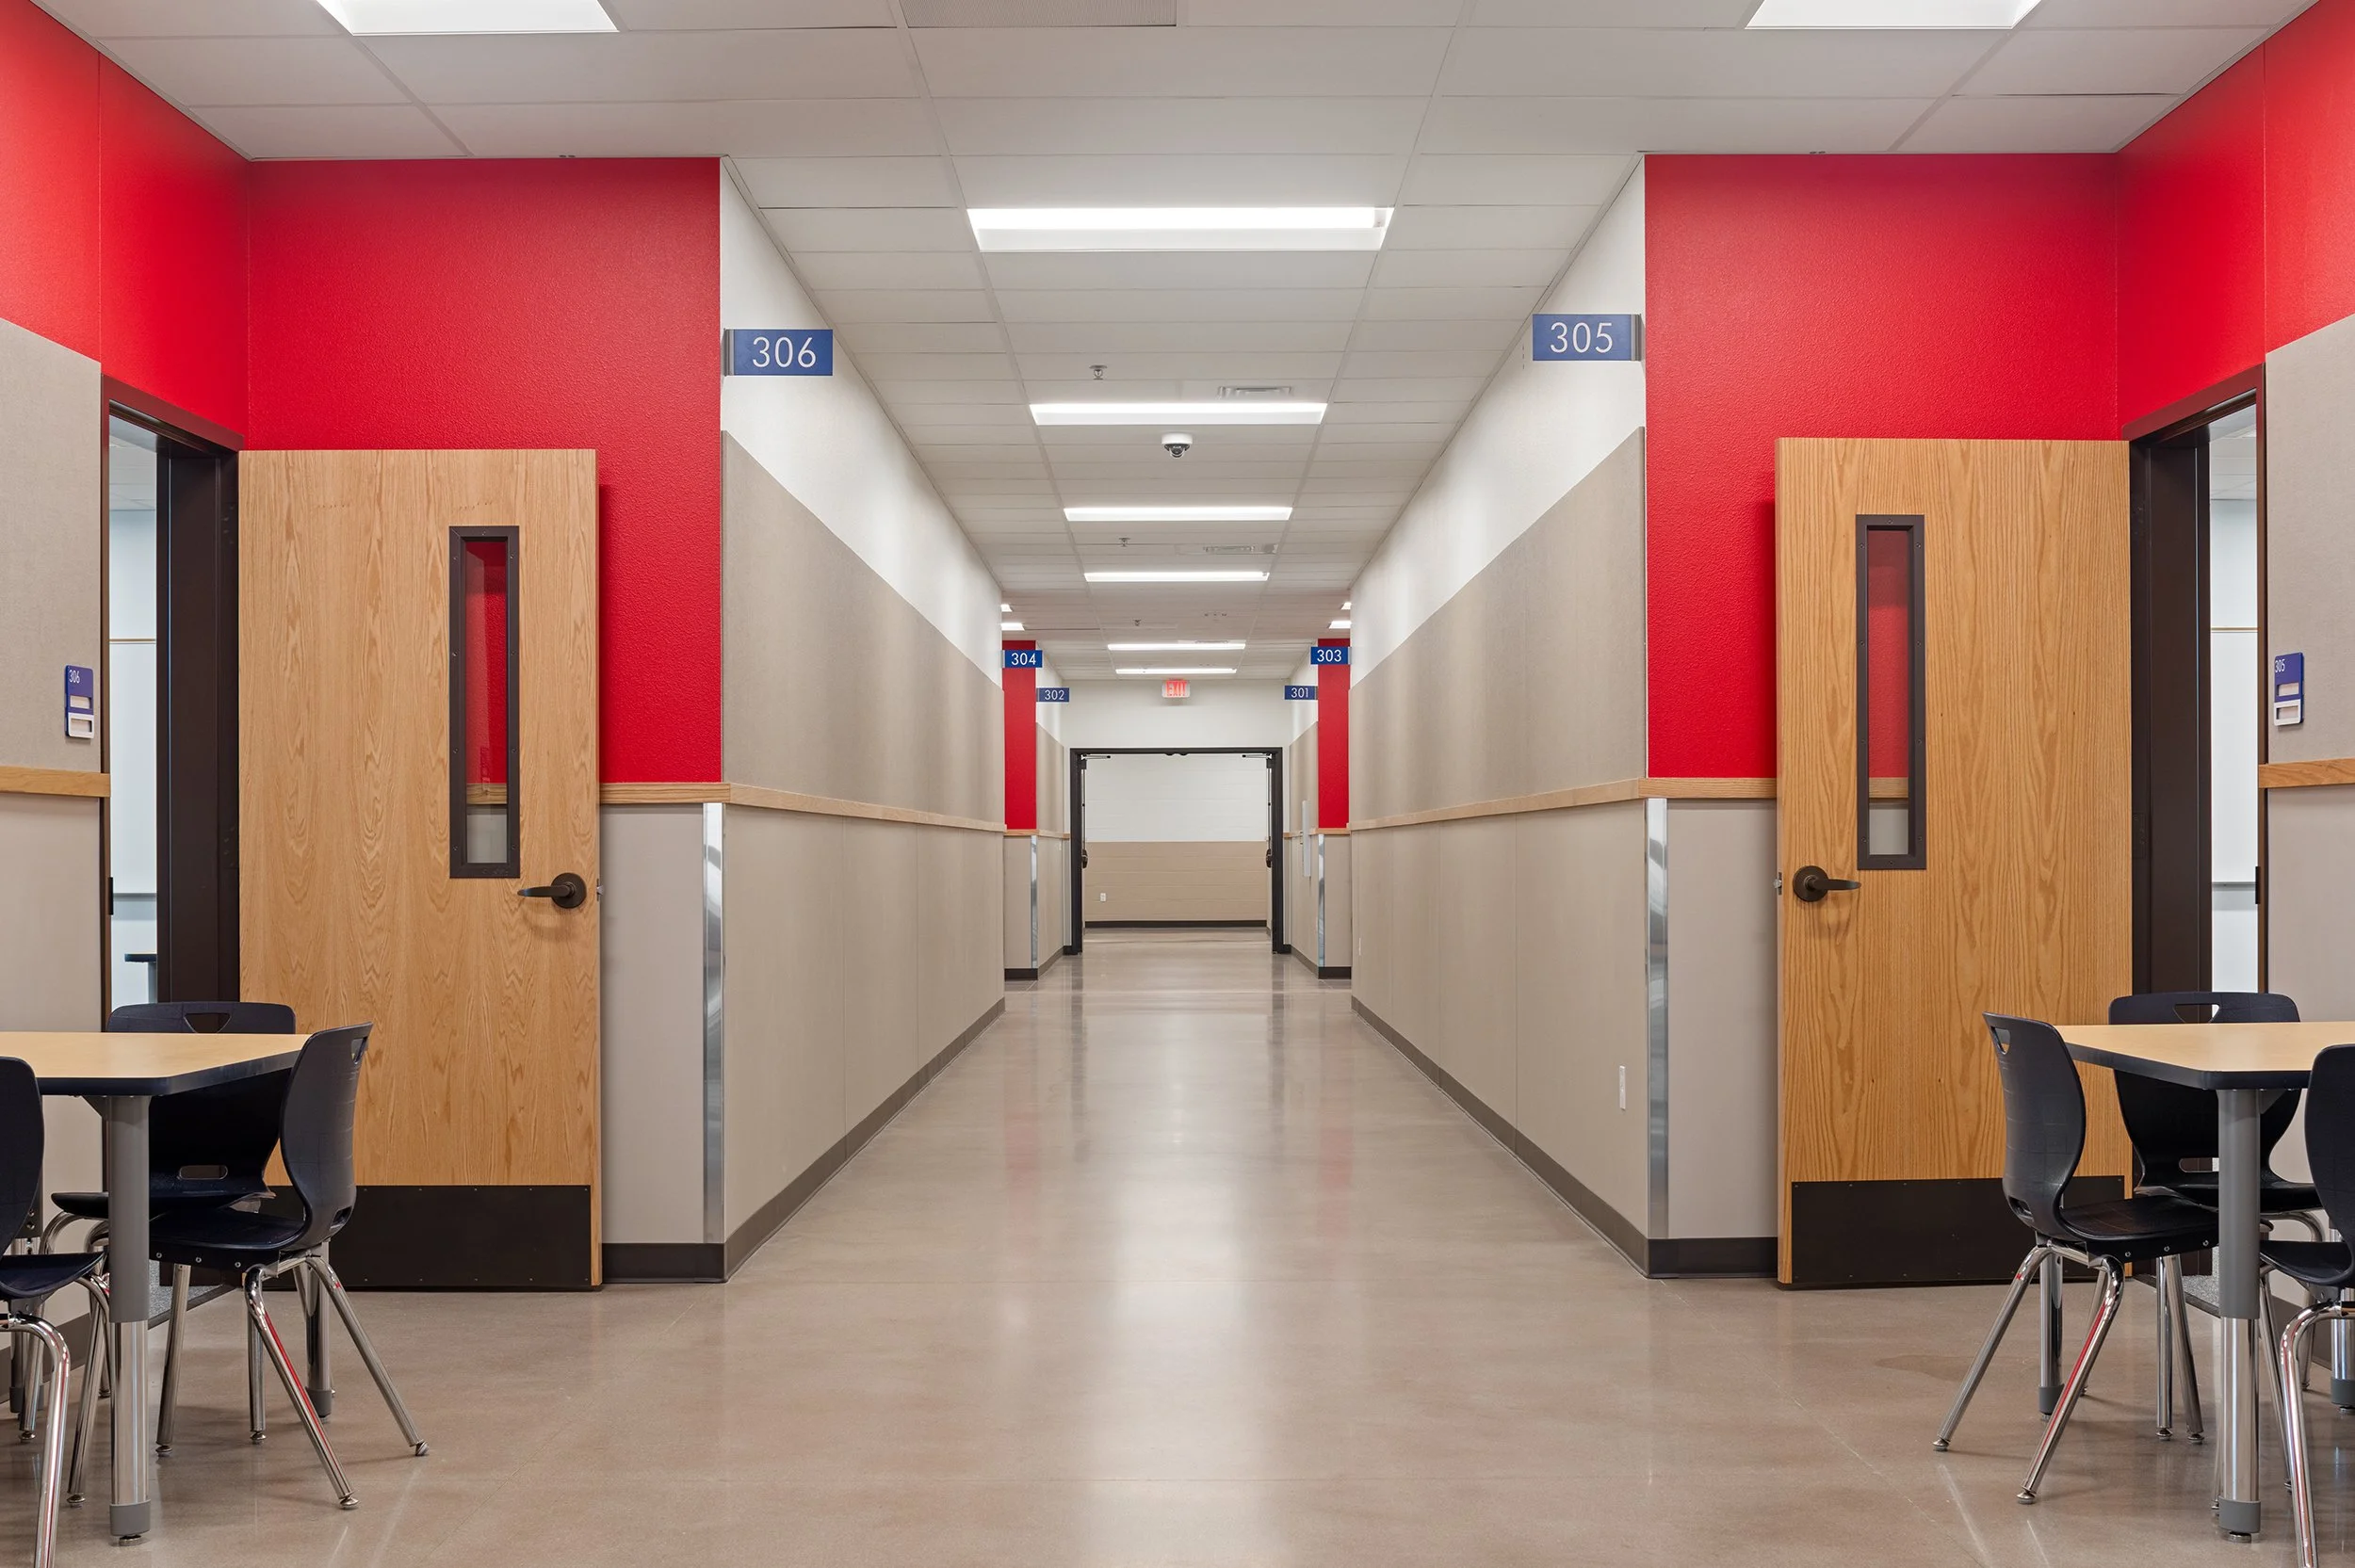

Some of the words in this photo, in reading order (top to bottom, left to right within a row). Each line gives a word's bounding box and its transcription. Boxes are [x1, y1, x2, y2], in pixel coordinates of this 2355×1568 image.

[1550, 321, 1614, 354] 305
[752, 336, 817, 368] 306
[1011, 652, 1036, 666] 304
[1317, 649, 1342, 662] 303
[69, 670, 80, 684] 306
[1044, 689, 1064, 701] 302
[1166, 680, 1187, 696] EXIT
[1291, 687, 1308, 698] 301
